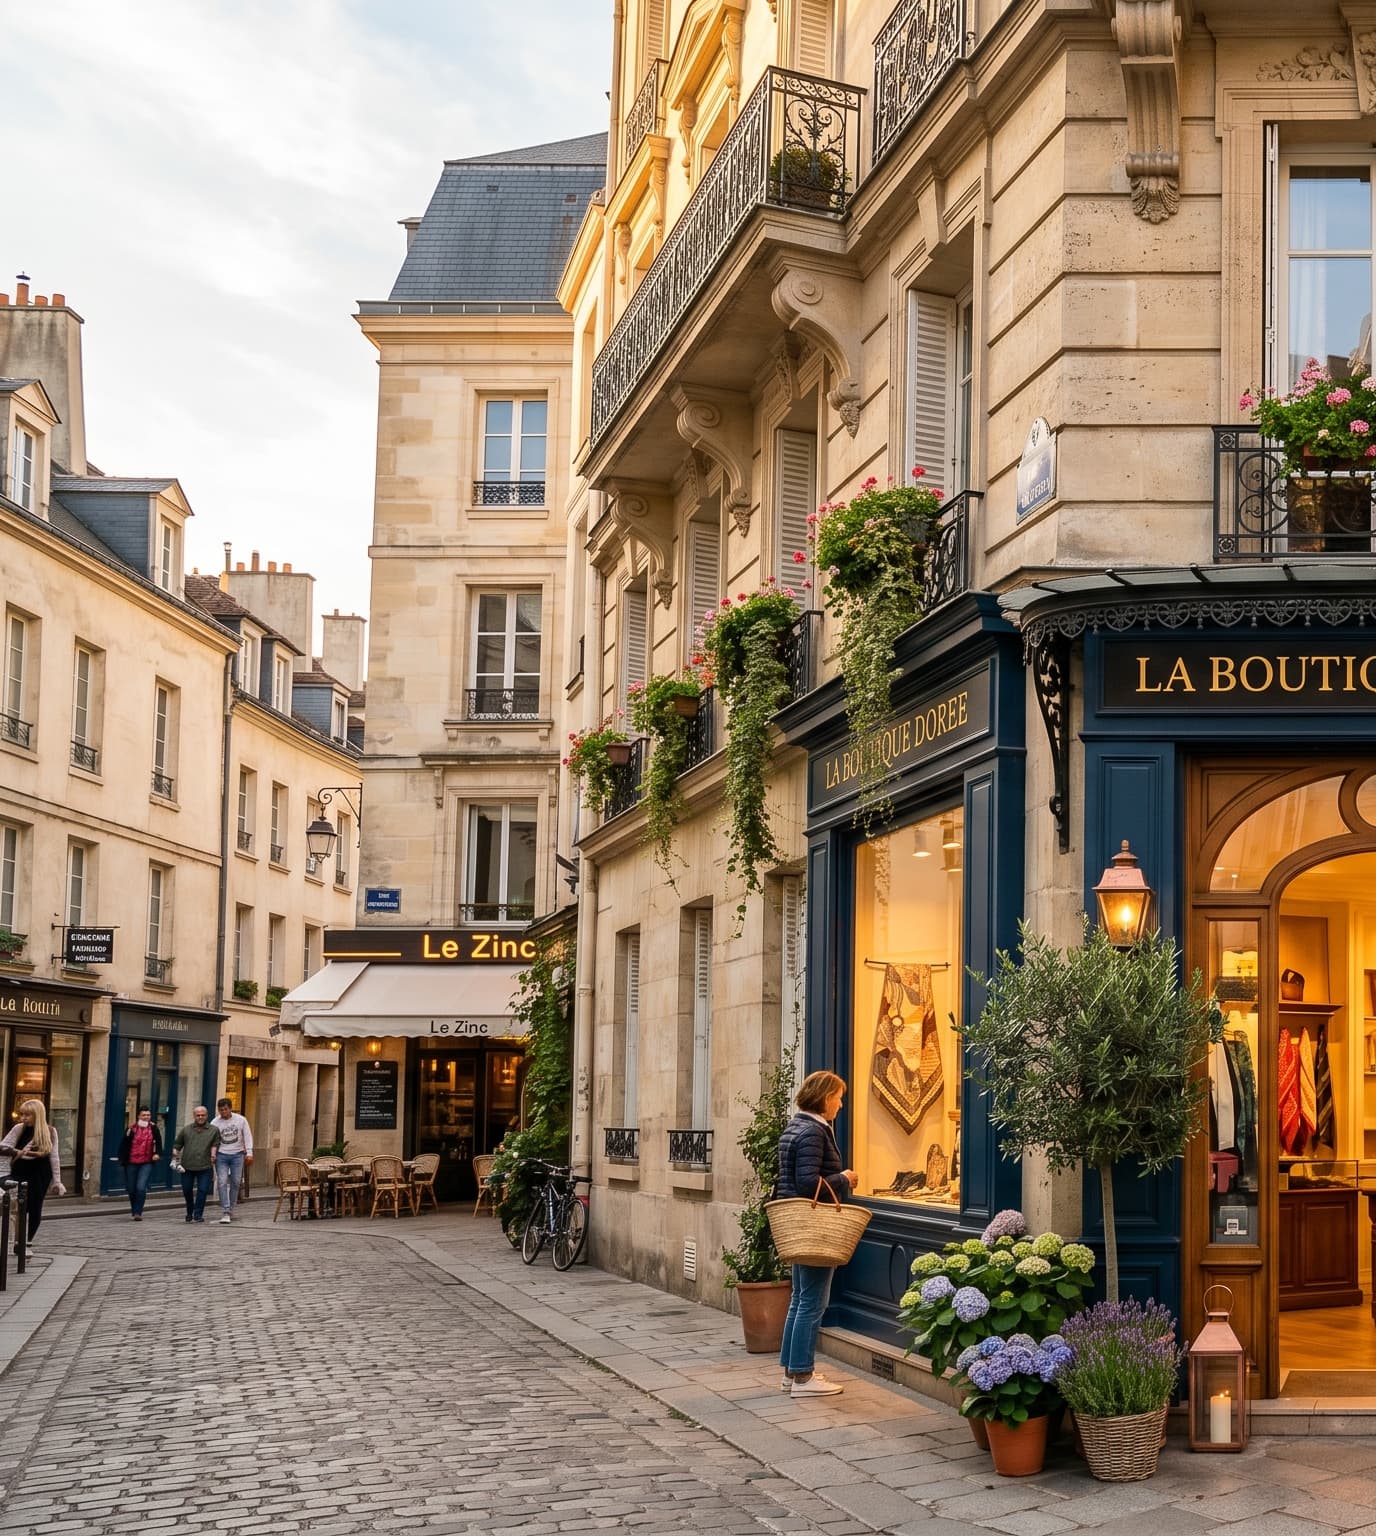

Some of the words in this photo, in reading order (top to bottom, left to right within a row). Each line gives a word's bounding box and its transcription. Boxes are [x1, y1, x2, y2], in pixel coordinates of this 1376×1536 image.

[1135, 656, 1196, 692] LA
[826, 757, 840, 789] LA
[914, 691, 968, 747] DOREE
[423, 934, 459, 958] Le
[471, 934, 537, 958] Zinc
[430, 1020, 449, 1034] Le
[454, 1020, 488, 1034] Zinc
